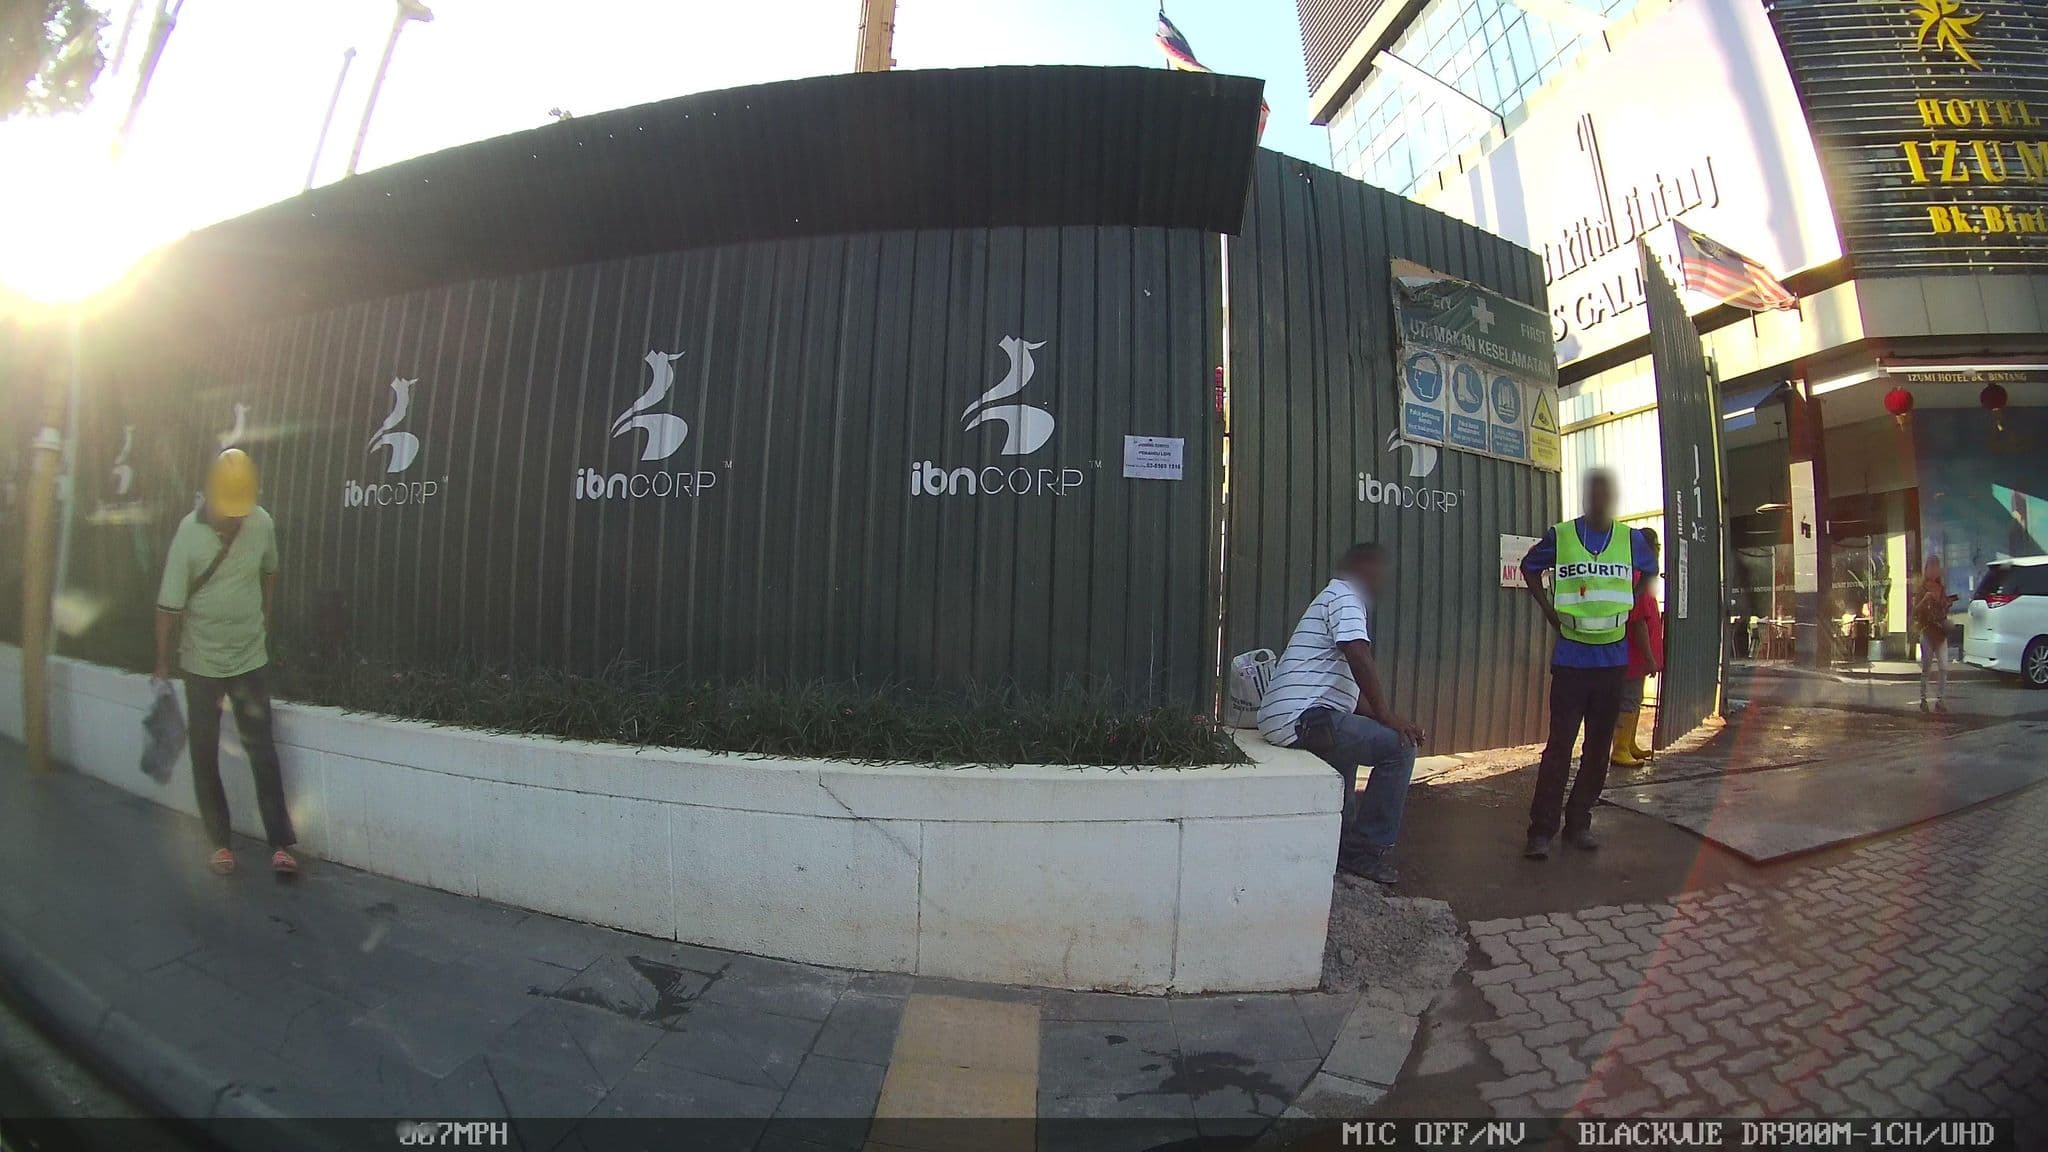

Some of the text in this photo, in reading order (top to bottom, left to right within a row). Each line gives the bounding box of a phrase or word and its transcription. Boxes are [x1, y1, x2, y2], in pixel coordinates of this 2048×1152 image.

[1915, 98, 2041, 128] HOTEL
[1899, 140, 2048, 184] IZUM
[1926, 204, 2048, 234] Bk.Bint
[1519, 322, 1547, 344] FIRST
[1478, 338, 1551, 376] KESELAMATAN
[1907, 373, 1936, 382] IZUMI
[1938, 373, 1969, 382] HOTEL
[1987, 372, 2027, 382] BINTANG
[1502, 564, 1519, 581] ANY
[1558, 563, 1631, 579] SECURITY
